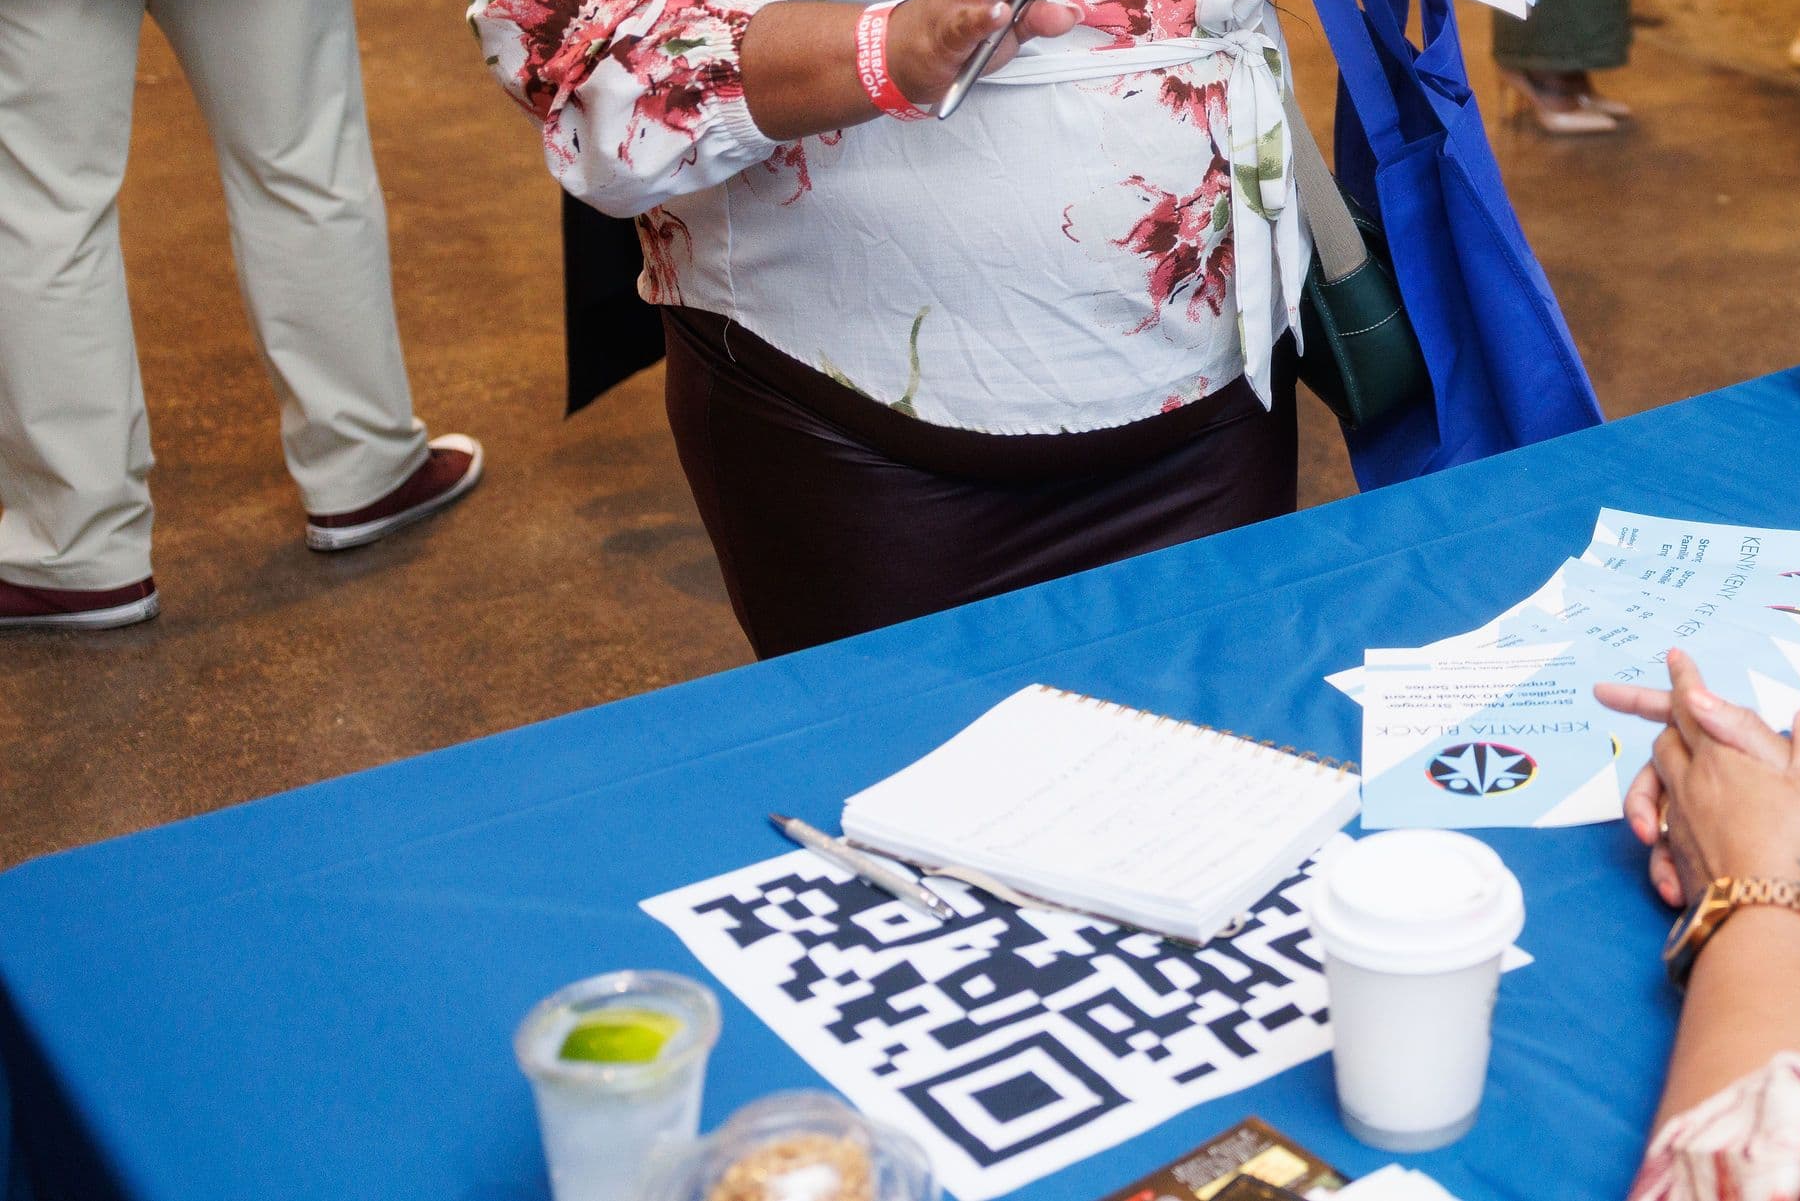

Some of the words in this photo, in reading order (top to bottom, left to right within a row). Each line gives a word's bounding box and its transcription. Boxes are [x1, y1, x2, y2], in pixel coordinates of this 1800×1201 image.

[857, 13, 882, 98] ADMISSION
[871, 17, 886, 87] GENERAL
[1454, 680, 1556, 691] Empowerment
[1388, 702, 1452, 710] Stronger
[1508, 698, 1574, 708] Stronger
[1375, 724, 1460, 736] BLACK
[1470, 720, 1589, 736] KENYATTA
